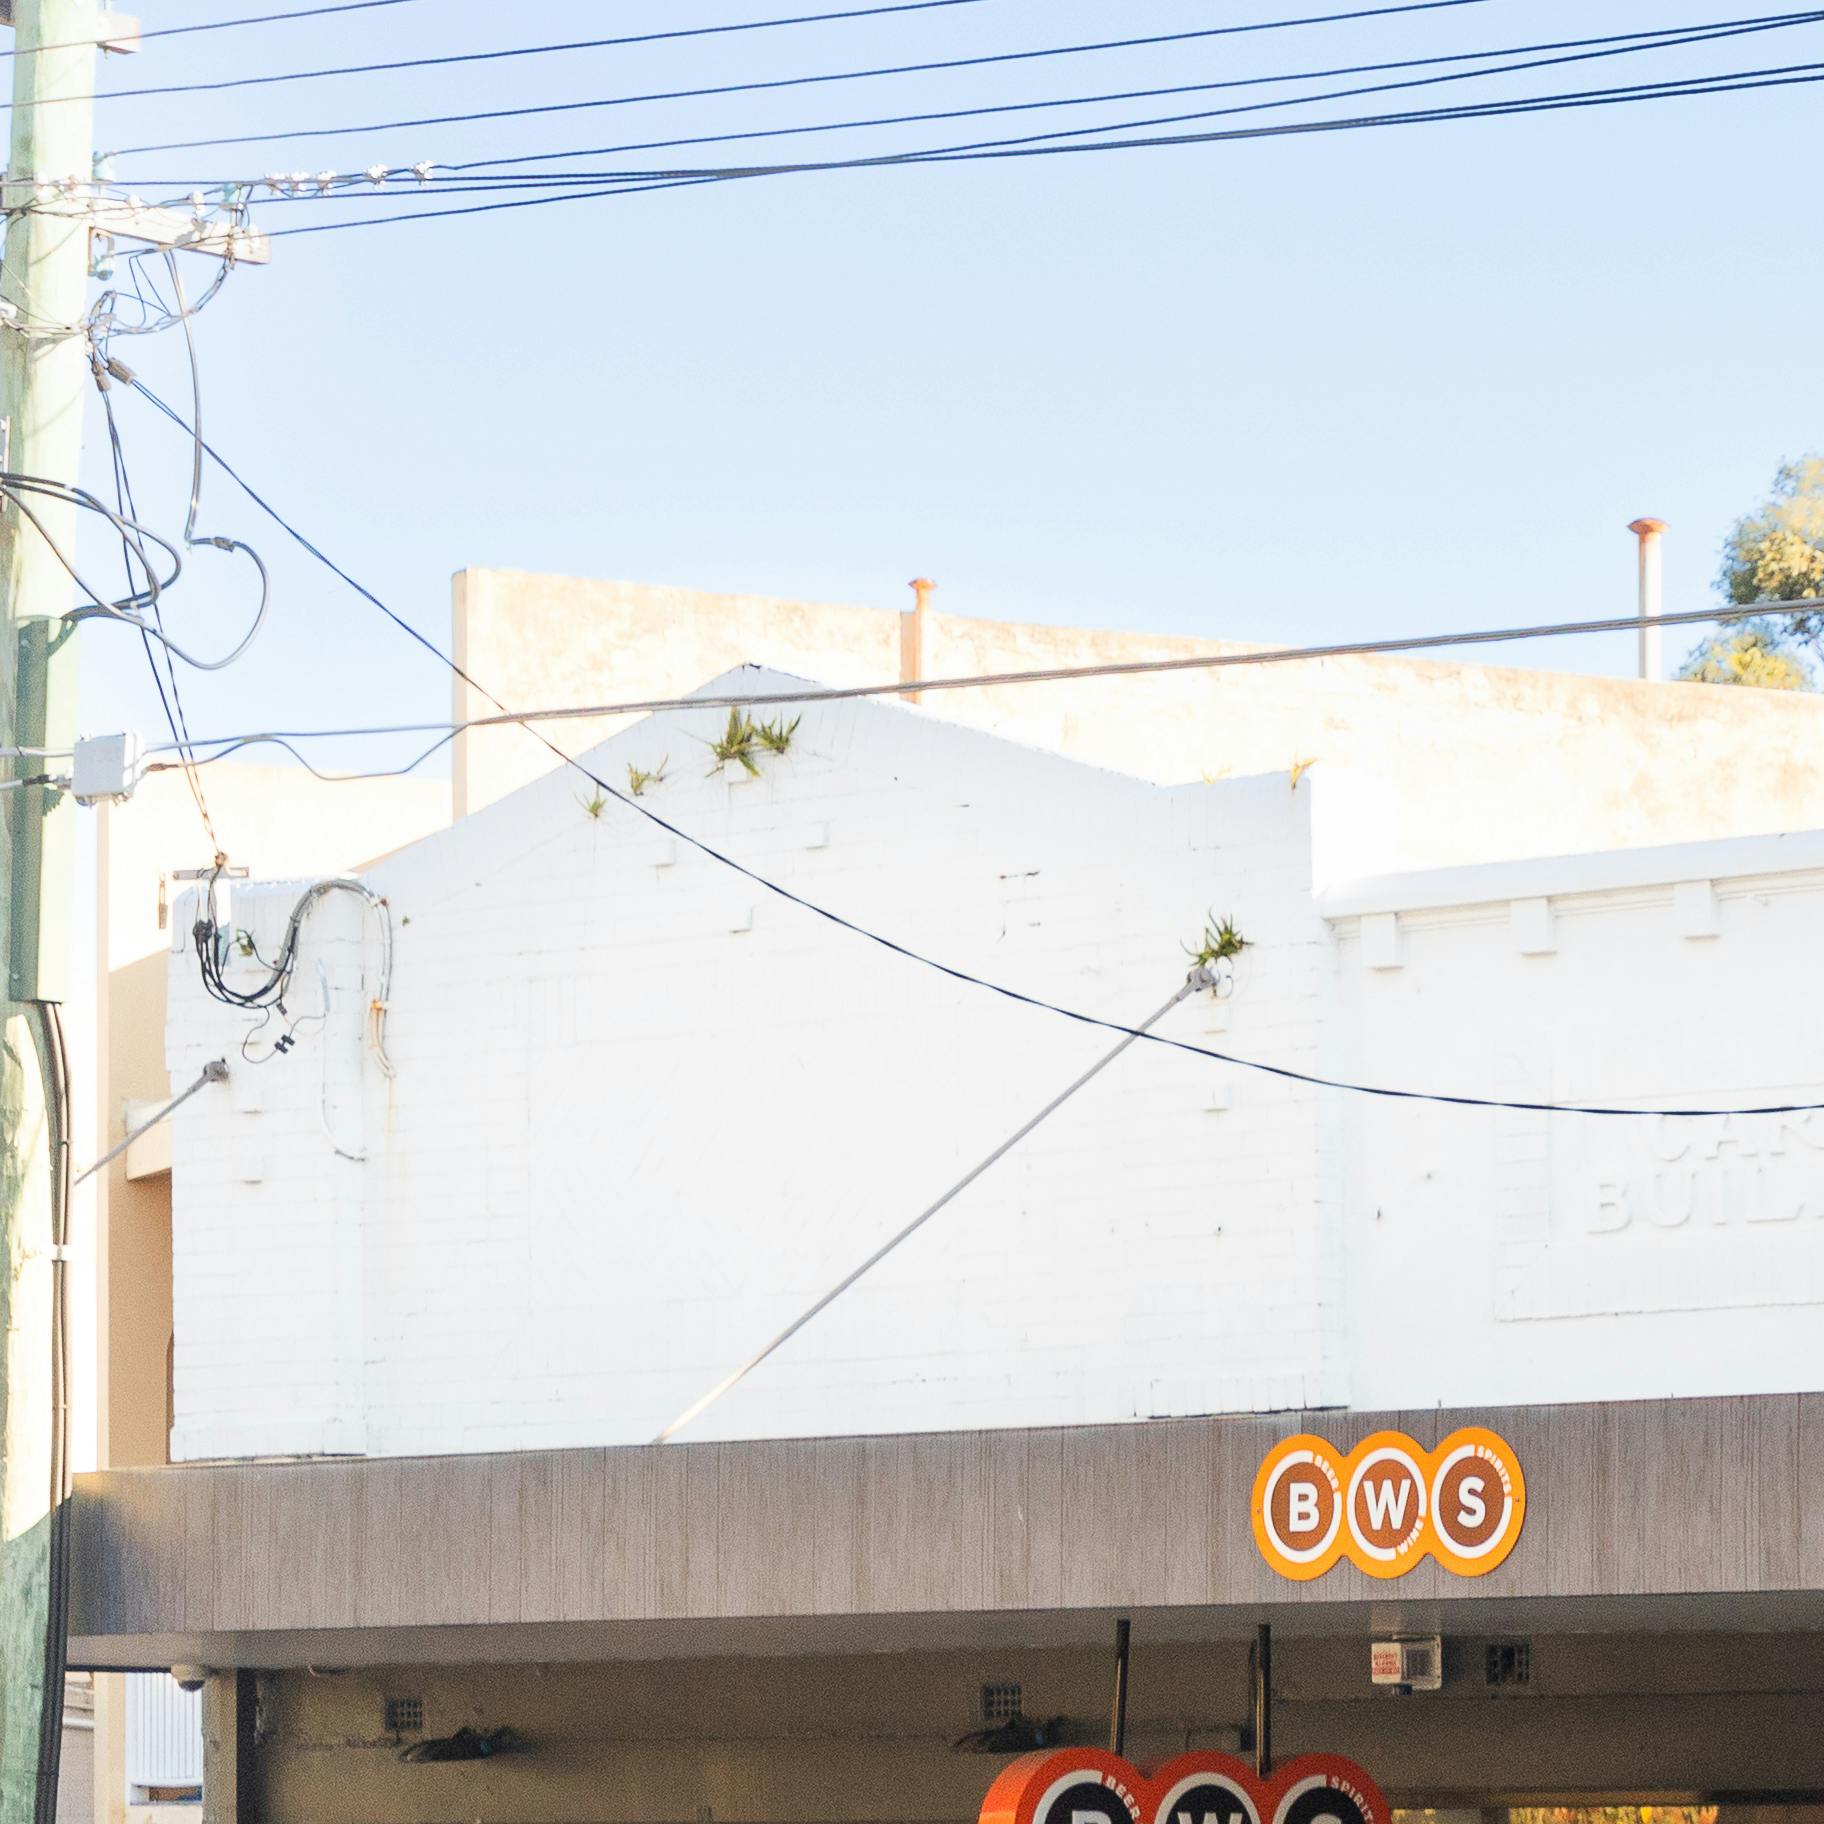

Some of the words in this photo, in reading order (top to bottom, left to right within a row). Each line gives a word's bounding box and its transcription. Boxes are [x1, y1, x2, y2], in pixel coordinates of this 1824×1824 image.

[1476, 1444, 1512, 1495] SPIRITS
[1396, 1520, 1425, 1556] WINE
[1104, 1775, 1141, 1822] BEER
